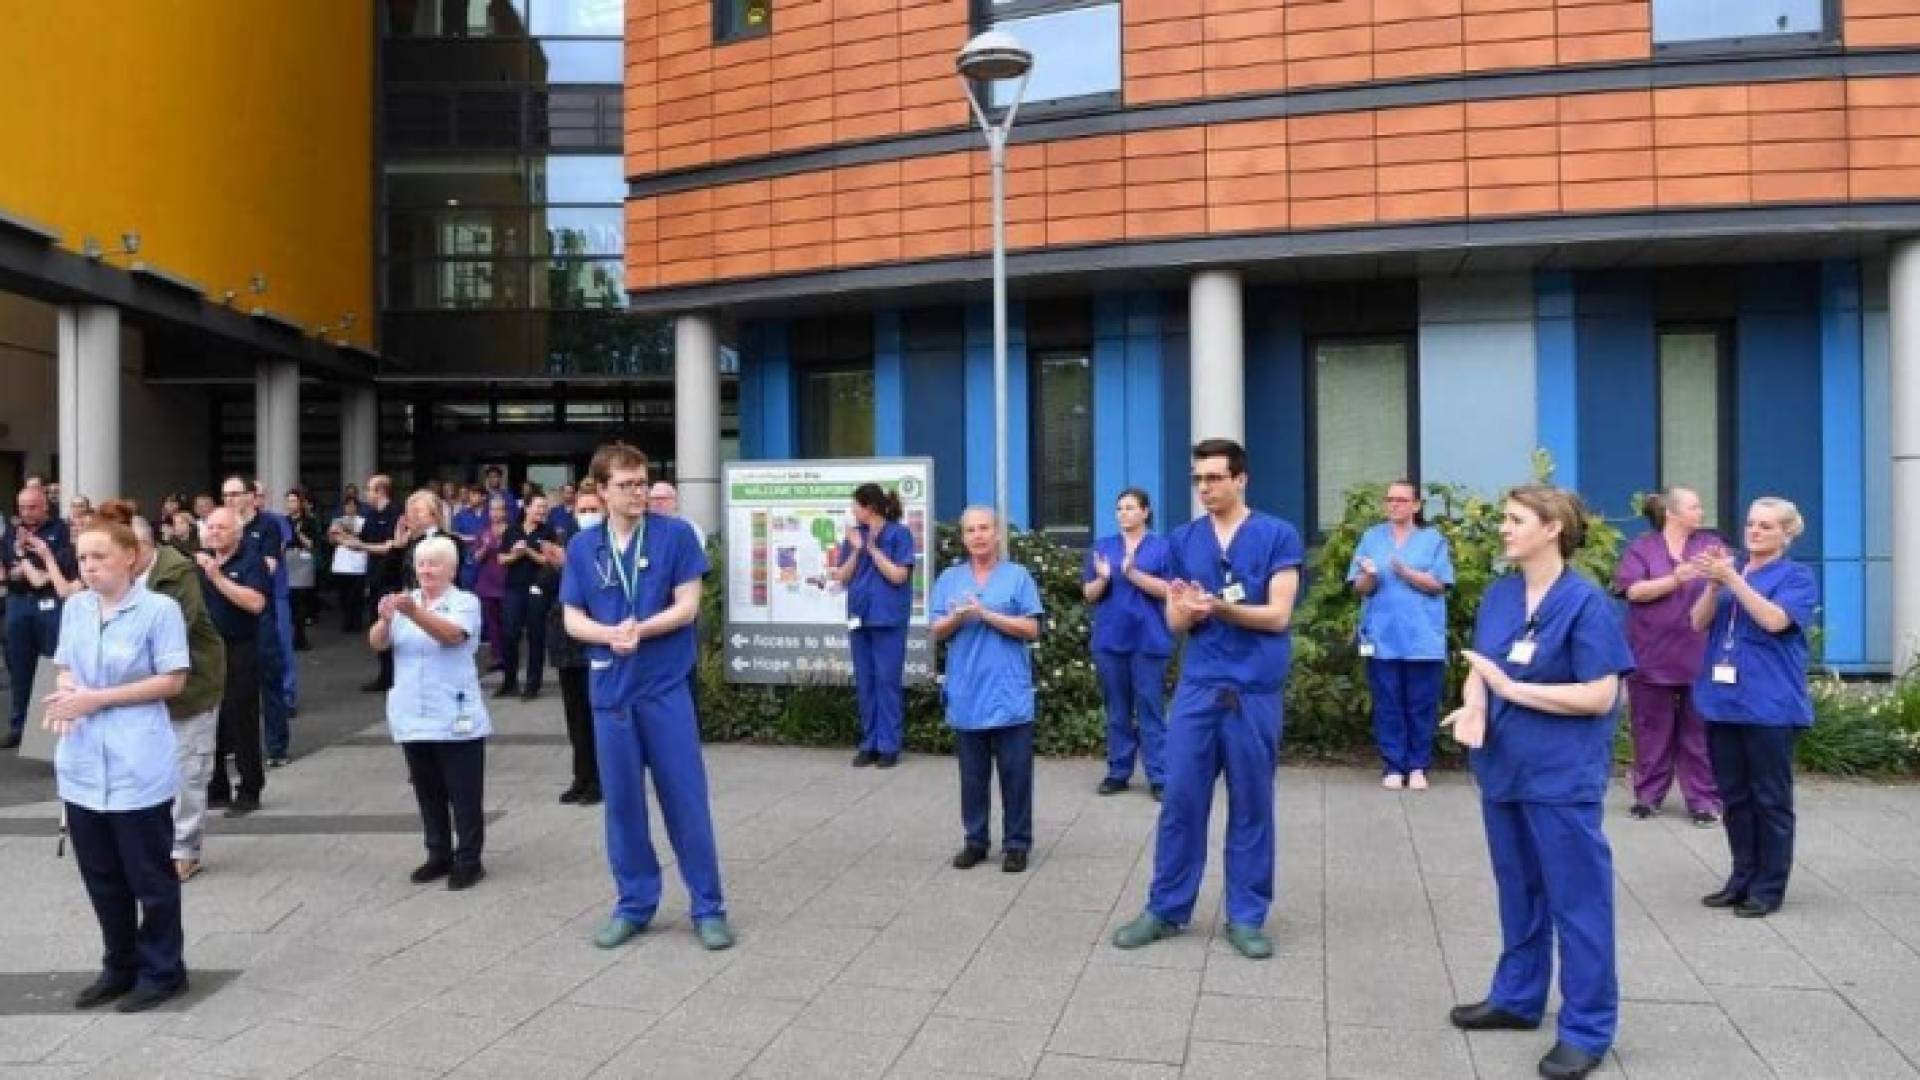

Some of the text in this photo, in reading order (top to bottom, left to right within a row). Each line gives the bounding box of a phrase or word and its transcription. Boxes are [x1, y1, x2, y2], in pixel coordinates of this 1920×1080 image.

[753, 634, 799, 648] Access
[804, 635, 819, 648] to
[753, 656, 790, 673] Hope
